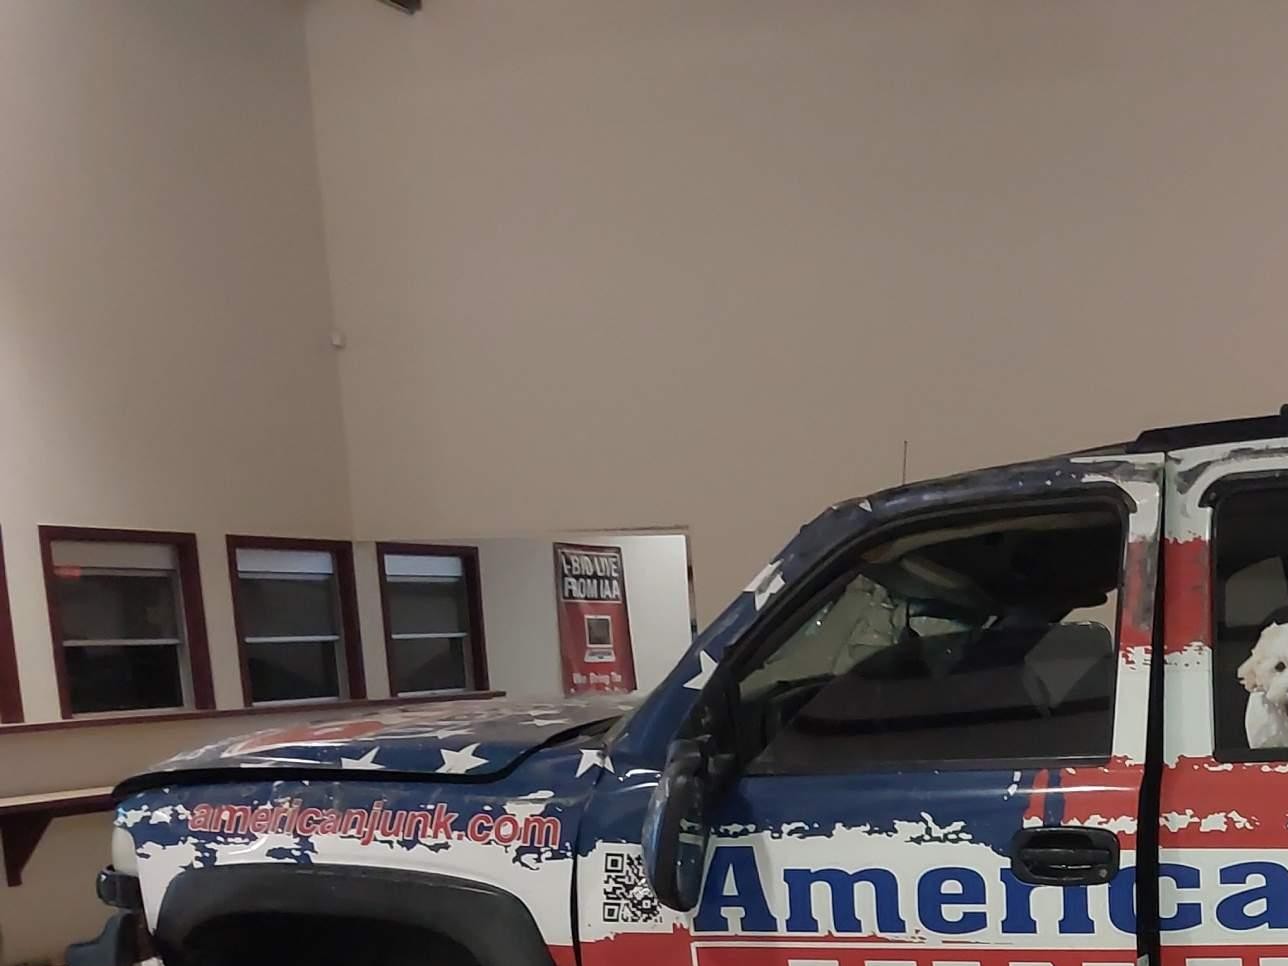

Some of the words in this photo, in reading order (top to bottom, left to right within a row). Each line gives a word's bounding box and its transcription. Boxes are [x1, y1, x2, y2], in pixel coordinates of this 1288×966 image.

[594, 556, 619, 577] LIVE
[564, 577, 598, 599] FROM
[599, 579, 621, 599] IAA
[188, 799, 561, 849] americanjunk.com
